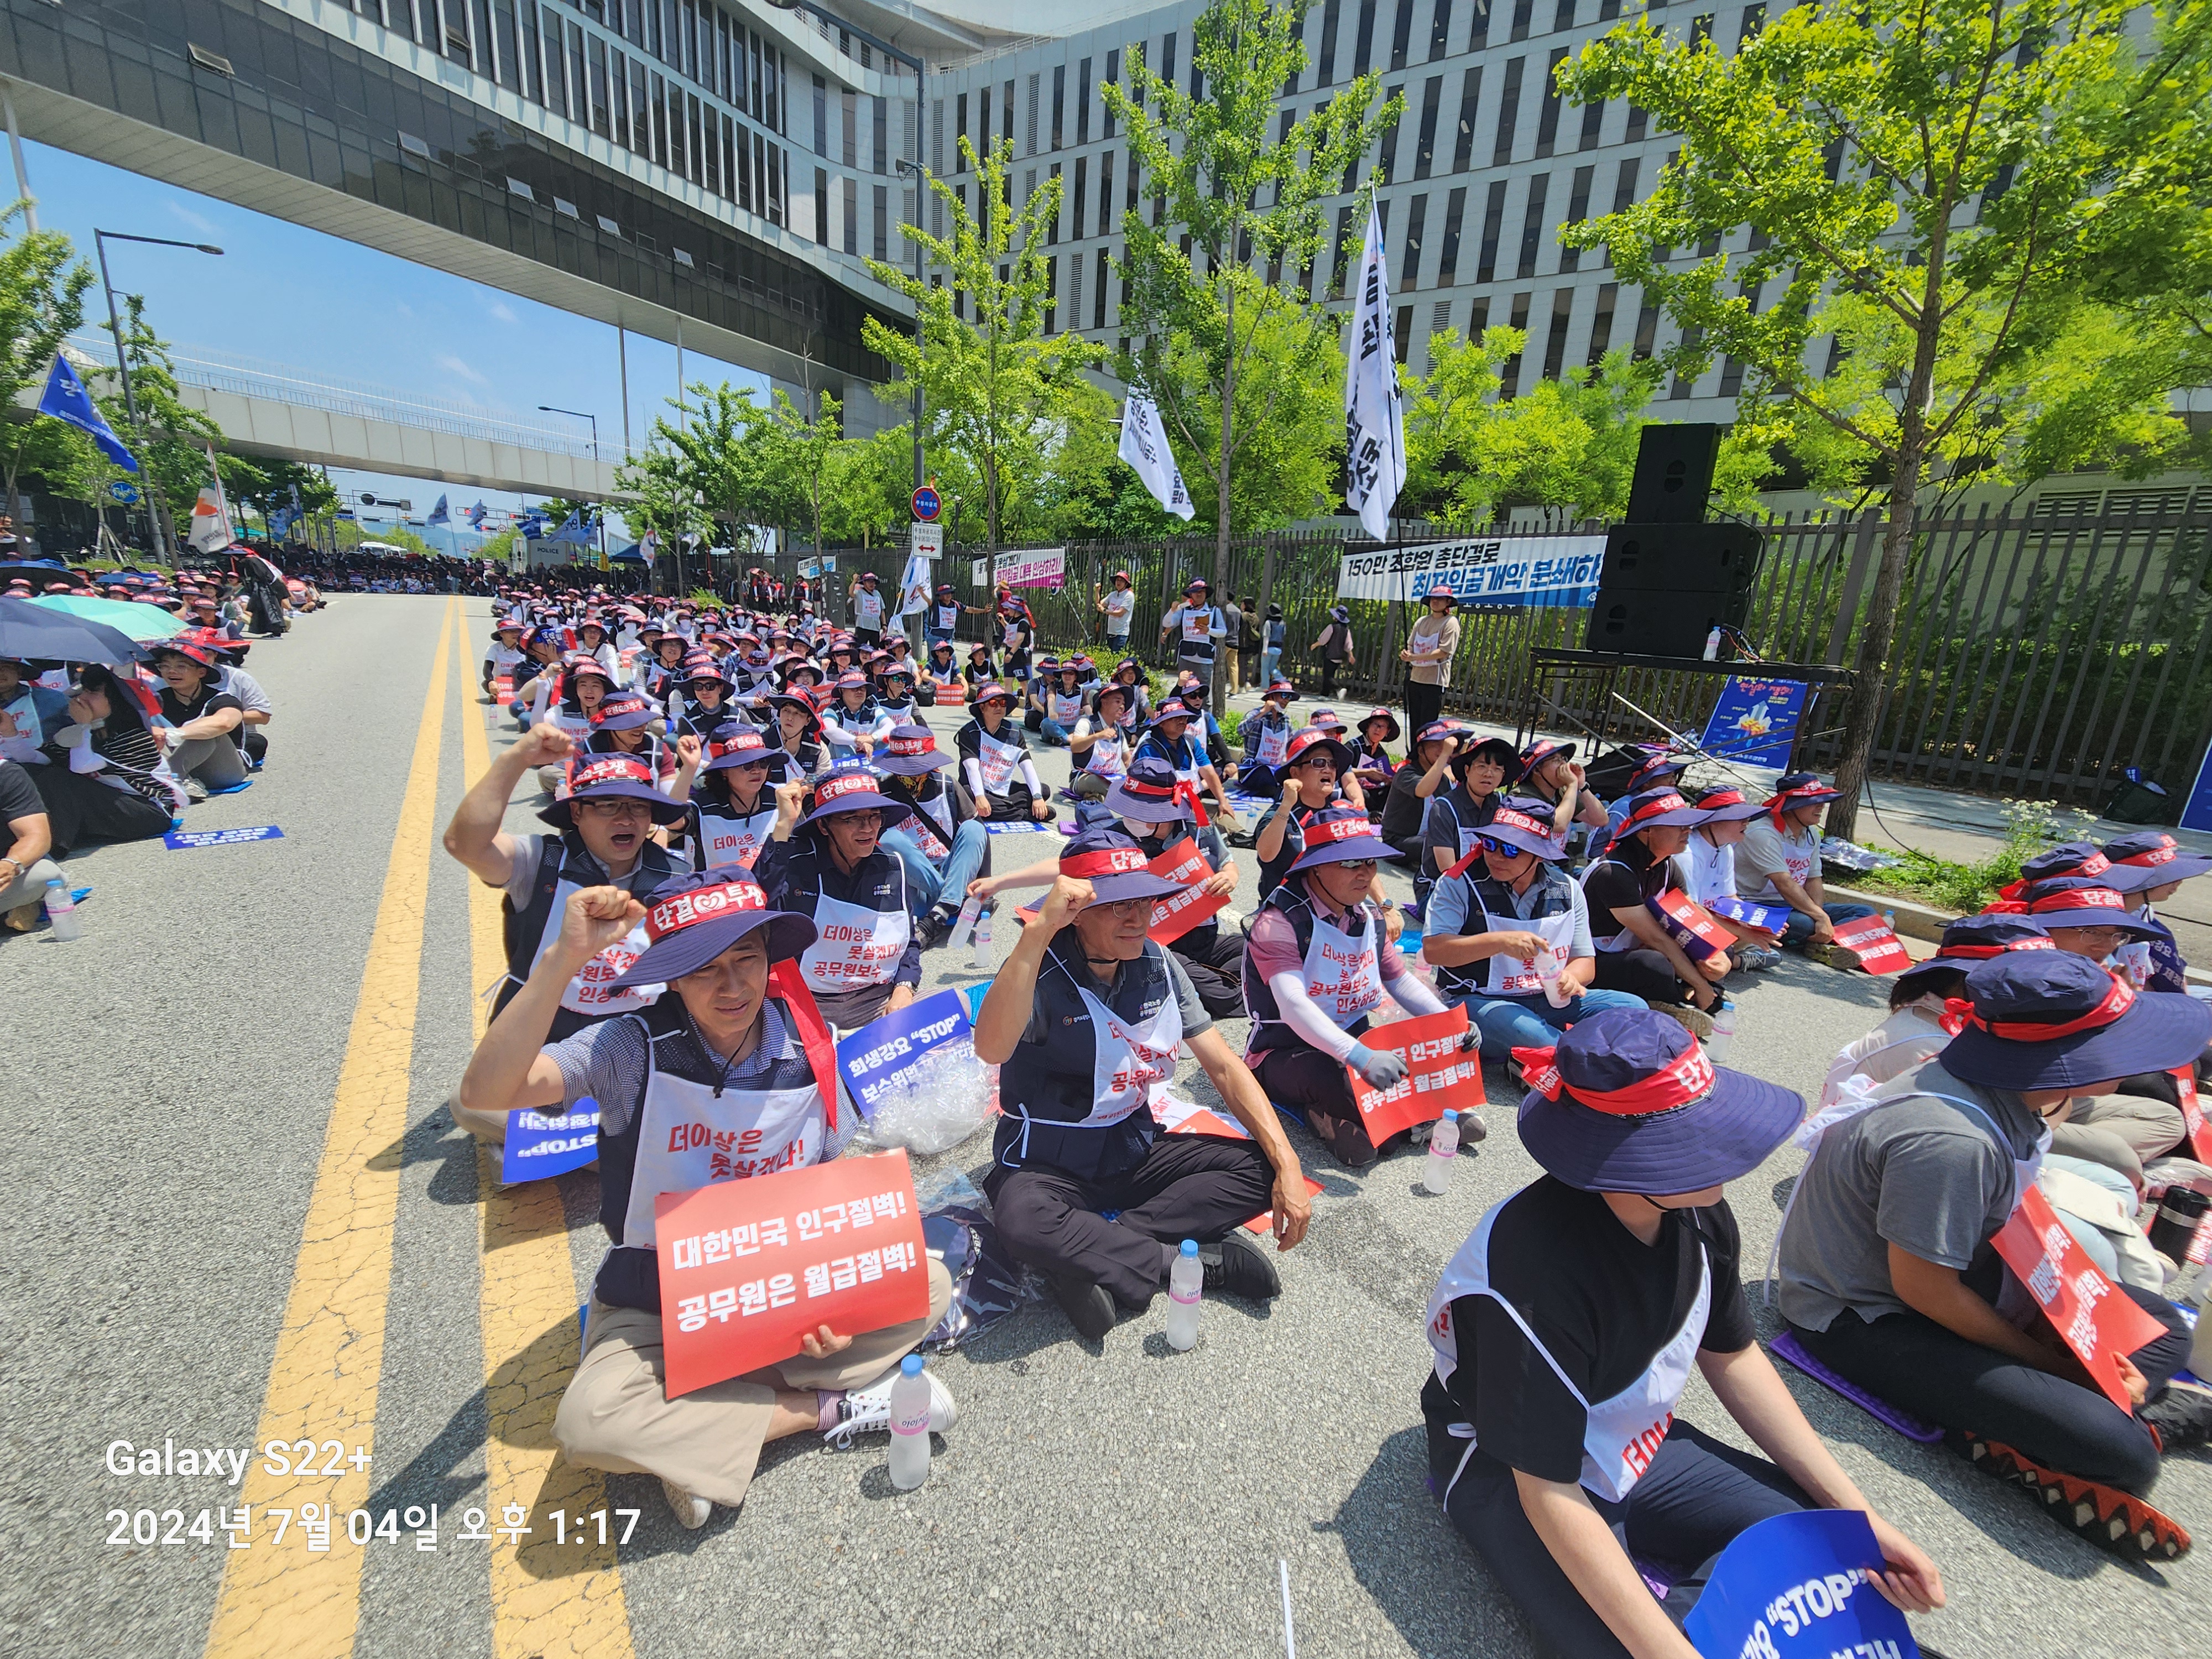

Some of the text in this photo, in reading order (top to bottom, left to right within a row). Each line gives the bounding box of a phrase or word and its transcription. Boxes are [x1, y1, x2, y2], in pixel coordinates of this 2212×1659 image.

[1019, 564, 1032, 579] 대폭
[1032, 556, 1062, 577] 인상하라!
[1348, 542, 1501, 576] 150만 조합원 총단결로
[1528, 554, 1602, 588] 분쇄하
[727, 735, 744, 750] 단결
[905, 740, 922, 752] 투쟁
[981, 744, 1004, 757] 더이상은
[593, 759, 627, 777] 투쟁
[979, 759, 1004, 773] 무원보수
[821, 779, 844, 800] 단결
[1659, 794, 1679, 810] 단결
[1496, 808, 1515, 824] 단결
[1330, 819, 1358, 837] 단결
[714, 833, 756, 851] 더이상은
[1111, 851, 1140, 870] 단결
[1162, 857, 1203, 883] 구절벽!
[2084, 858, 2109, 875] 단결
[654, 883, 765, 931] 단결 투쟁
[2083, 890, 2117, 905] 단결
[823, 925, 874, 942] 더이상은
[847, 943, 902, 961] 못살겠다!
[813, 961, 882, 979] 공무원보수
[1308, 973, 1370, 997] 공무원보수
[1337, 987, 1380, 1014] 인상하라!
[848, 1036, 912, 1078] 희생강요
[1414, 1061, 1475, 1093] 월급절벽!
[1674, 1042, 1714, 1094] 단결
[667, 1123, 763, 1155] 더이상은
[673, 1191, 907, 1270] 대한민국 인구절벽!
[677, 1241, 917, 1332] 공무원은 월급절벽!
